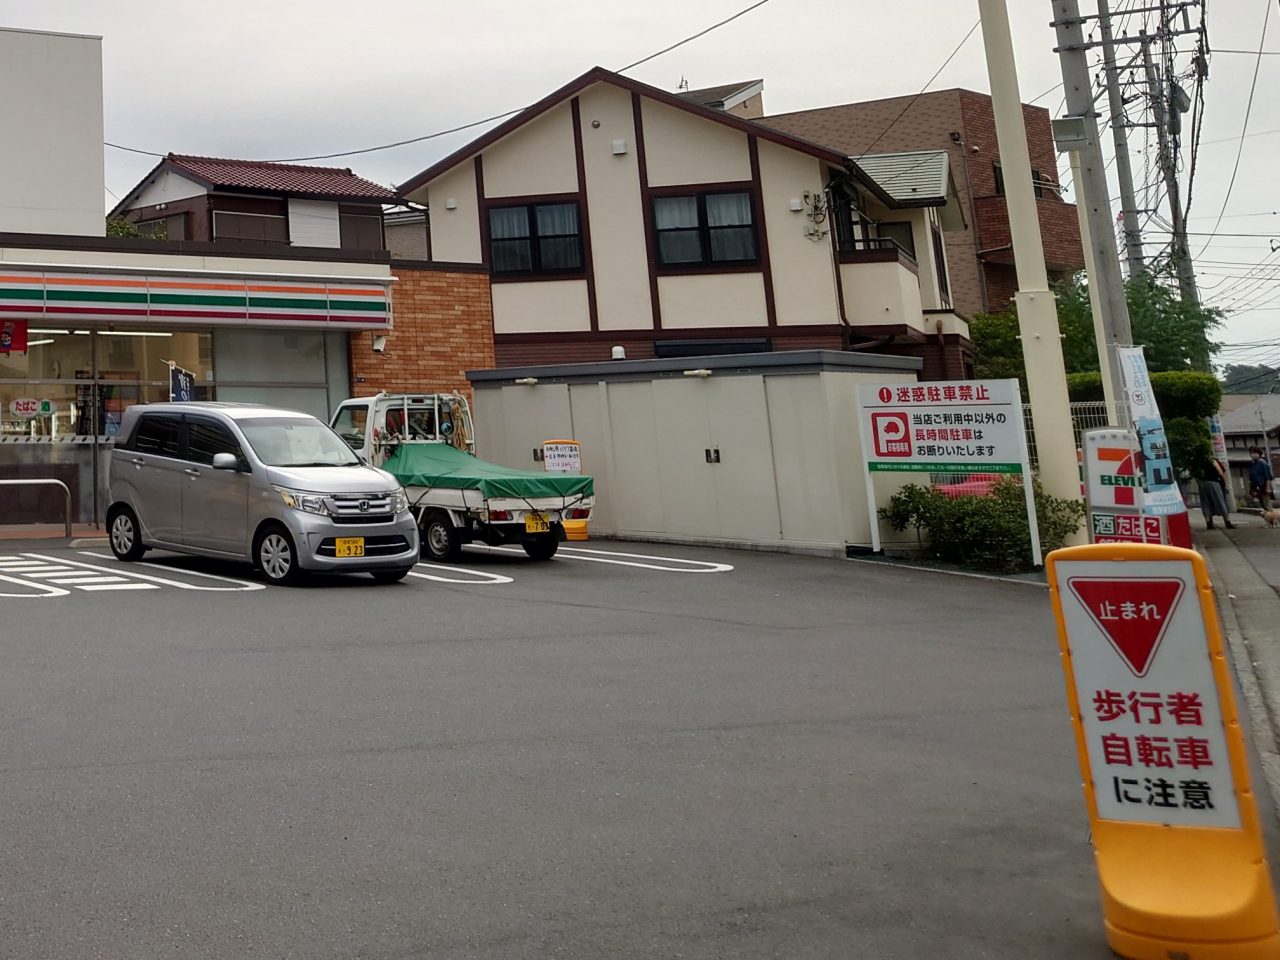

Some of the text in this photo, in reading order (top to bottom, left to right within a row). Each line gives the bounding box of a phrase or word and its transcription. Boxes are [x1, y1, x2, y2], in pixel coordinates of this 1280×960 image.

[896, 385, 990, 403] 迷惑駐車禁止
[913, 413, 1006, 425] 当店ご利用中以外の
[915, 429, 984, 441] 長時間駐車は
[917, 445, 995, 457] お断りいたします
[1094, 516, 1115, 535] 酒
[1099, 600, 1161, 620] 止まれ
[1093, 690, 1204, 727] 歩行者
[1101, 733, 1214, 769] 自転車
[1112, 776, 1215, 810] に注意
